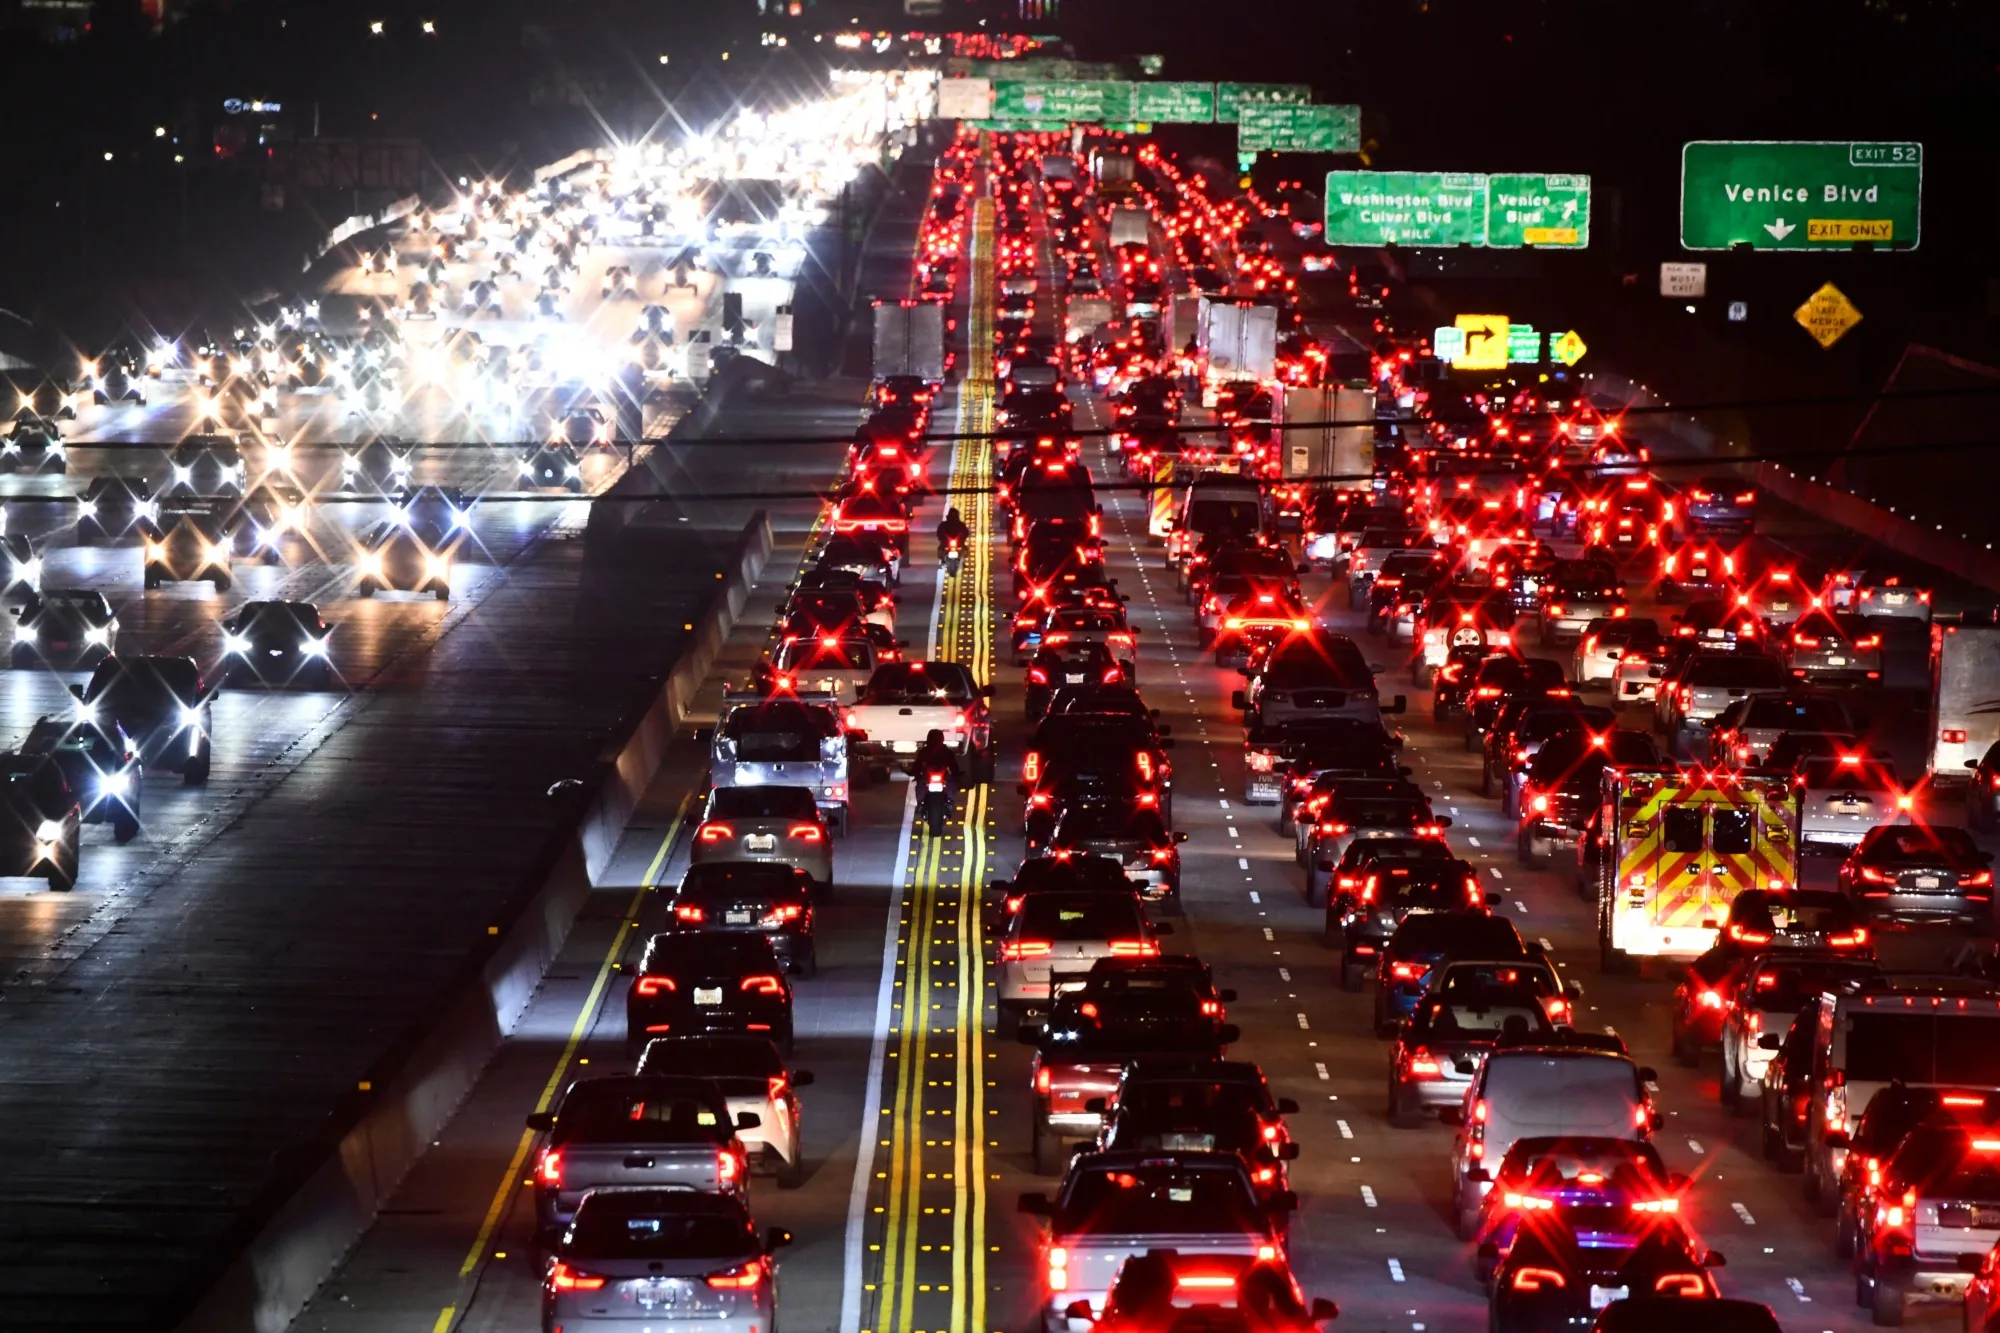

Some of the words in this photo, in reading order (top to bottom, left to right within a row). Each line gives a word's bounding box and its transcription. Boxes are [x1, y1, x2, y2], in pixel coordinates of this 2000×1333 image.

[1855, 149, 1886, 160] EXIT
[1892, 148, 1917, 161] 52
[1725, 184, 1809, 202] Venice
[1824, 184, 1878, 202] Blvd
[1340, 193, 1430, 208] Washington
[1438, 193, 1473, 207] Blvd
[1498, 193, 1551, 207] Venice
[1360, 210, 1411, 223] Culver
[1416, 210, 1452, 223] Blvd
[1506, 210, 1541, 223] Blvd
[1401, 229, 1431, 240] MILE
[1810, 224, 1842, 236] EXIT
[1850, 224, 1890, 236] ONLY
